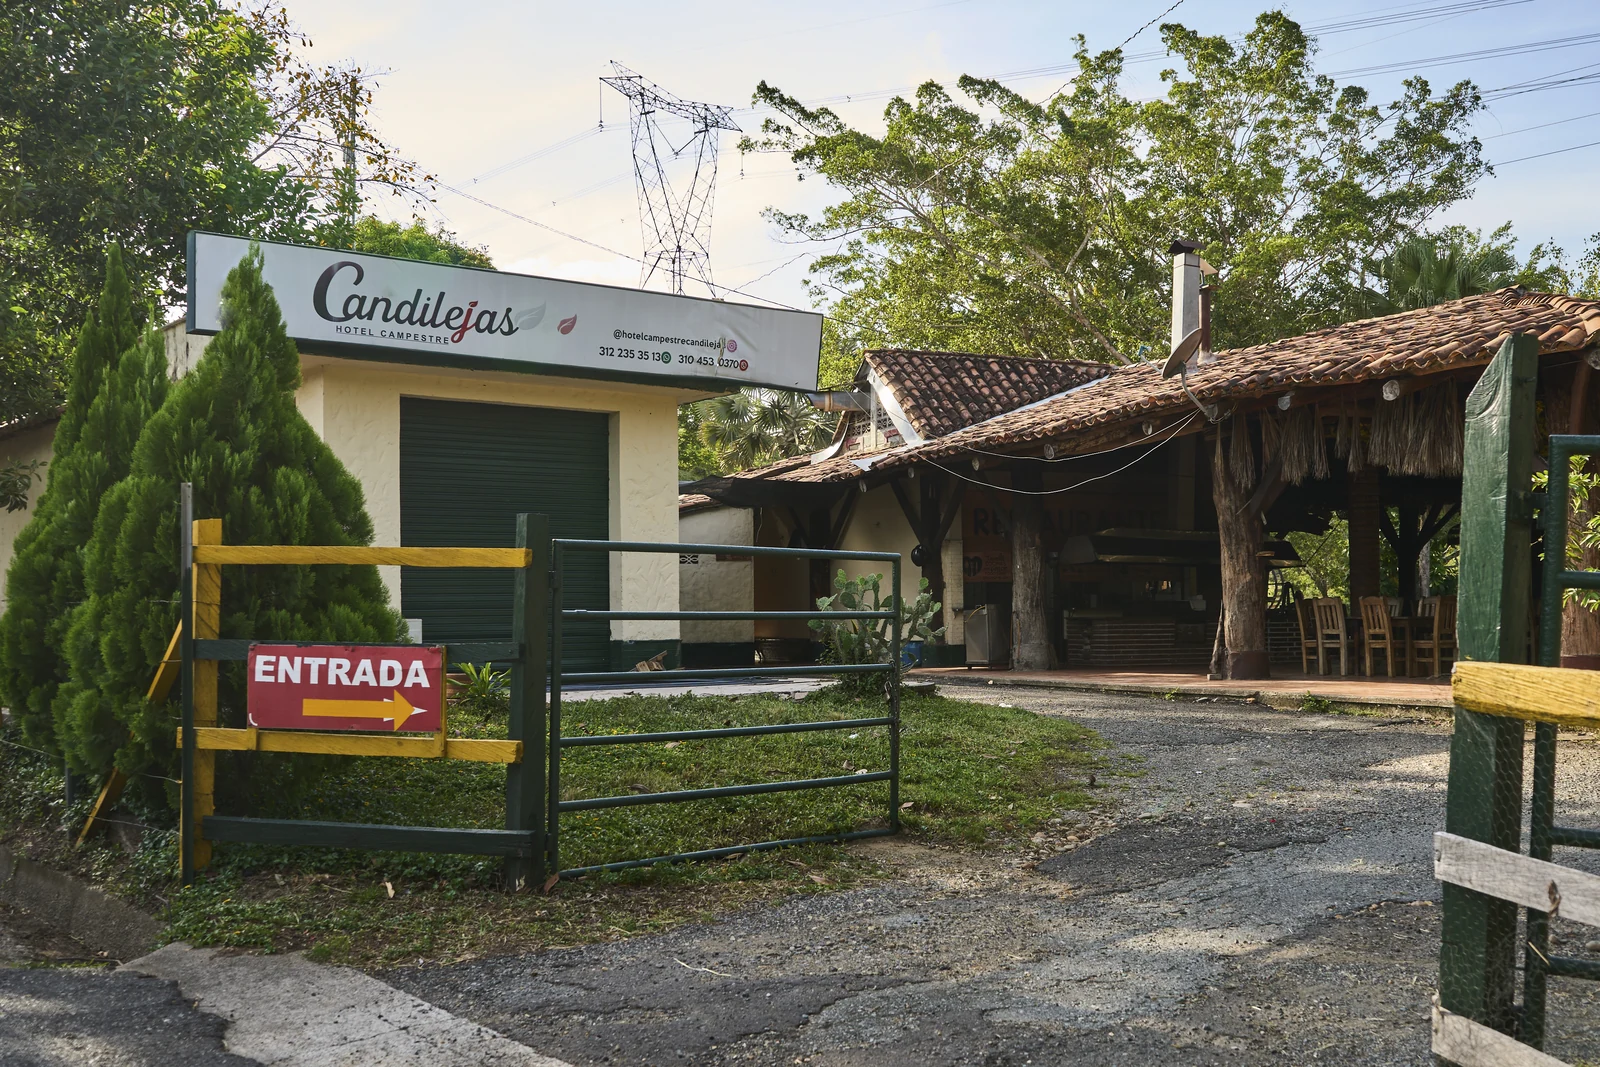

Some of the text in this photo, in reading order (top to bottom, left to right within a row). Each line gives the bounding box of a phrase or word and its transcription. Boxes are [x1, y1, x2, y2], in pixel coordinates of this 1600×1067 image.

[312, 260, 519, 344] Candilejas
[335, 325, 450, 345] HOTEL CAMPESTRE
[598, 346, 740, 369] 312 235 35 13 310 453 0370
[254, 654, 431, 688] ENTRADA
